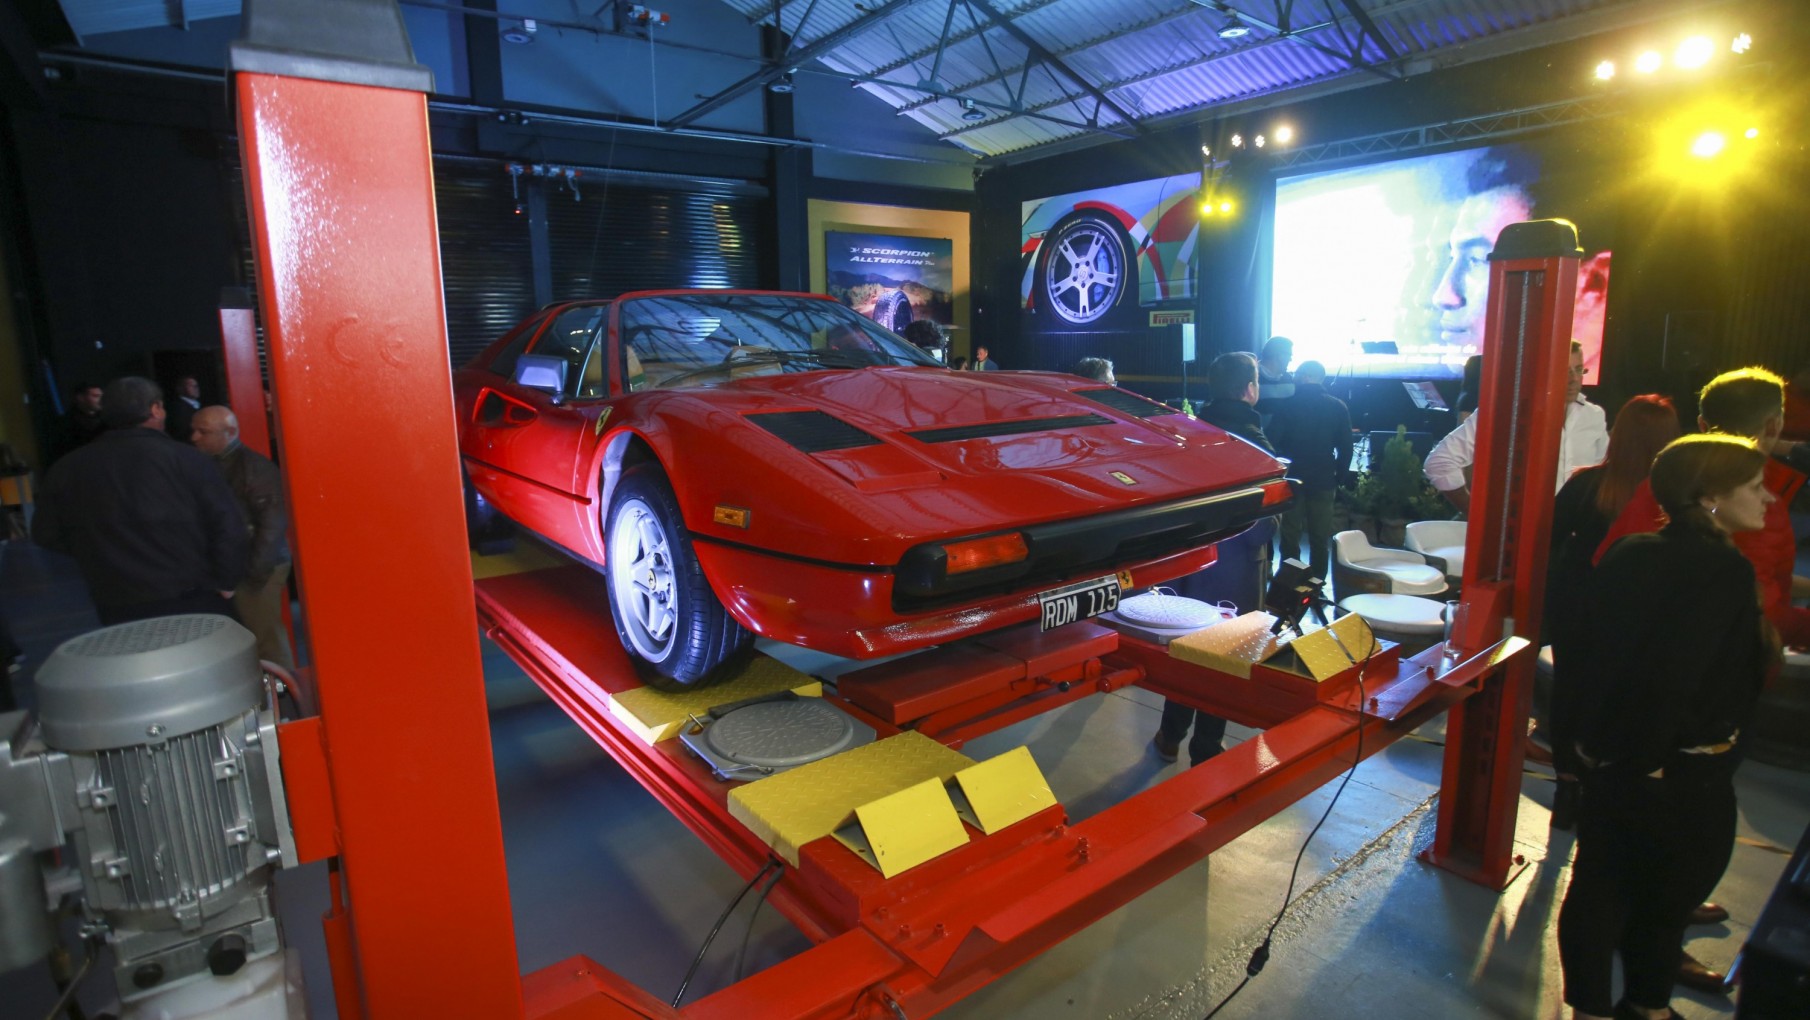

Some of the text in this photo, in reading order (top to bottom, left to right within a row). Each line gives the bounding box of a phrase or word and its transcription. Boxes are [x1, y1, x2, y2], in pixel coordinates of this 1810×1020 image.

[862, 248, 930, 257] SCORPION
[850, 256, 923, 265] ALLTERRAIN
[1153, 313, 1191, 325] PIRELLI
[1045, 585, 1118, 629] RDM 115
